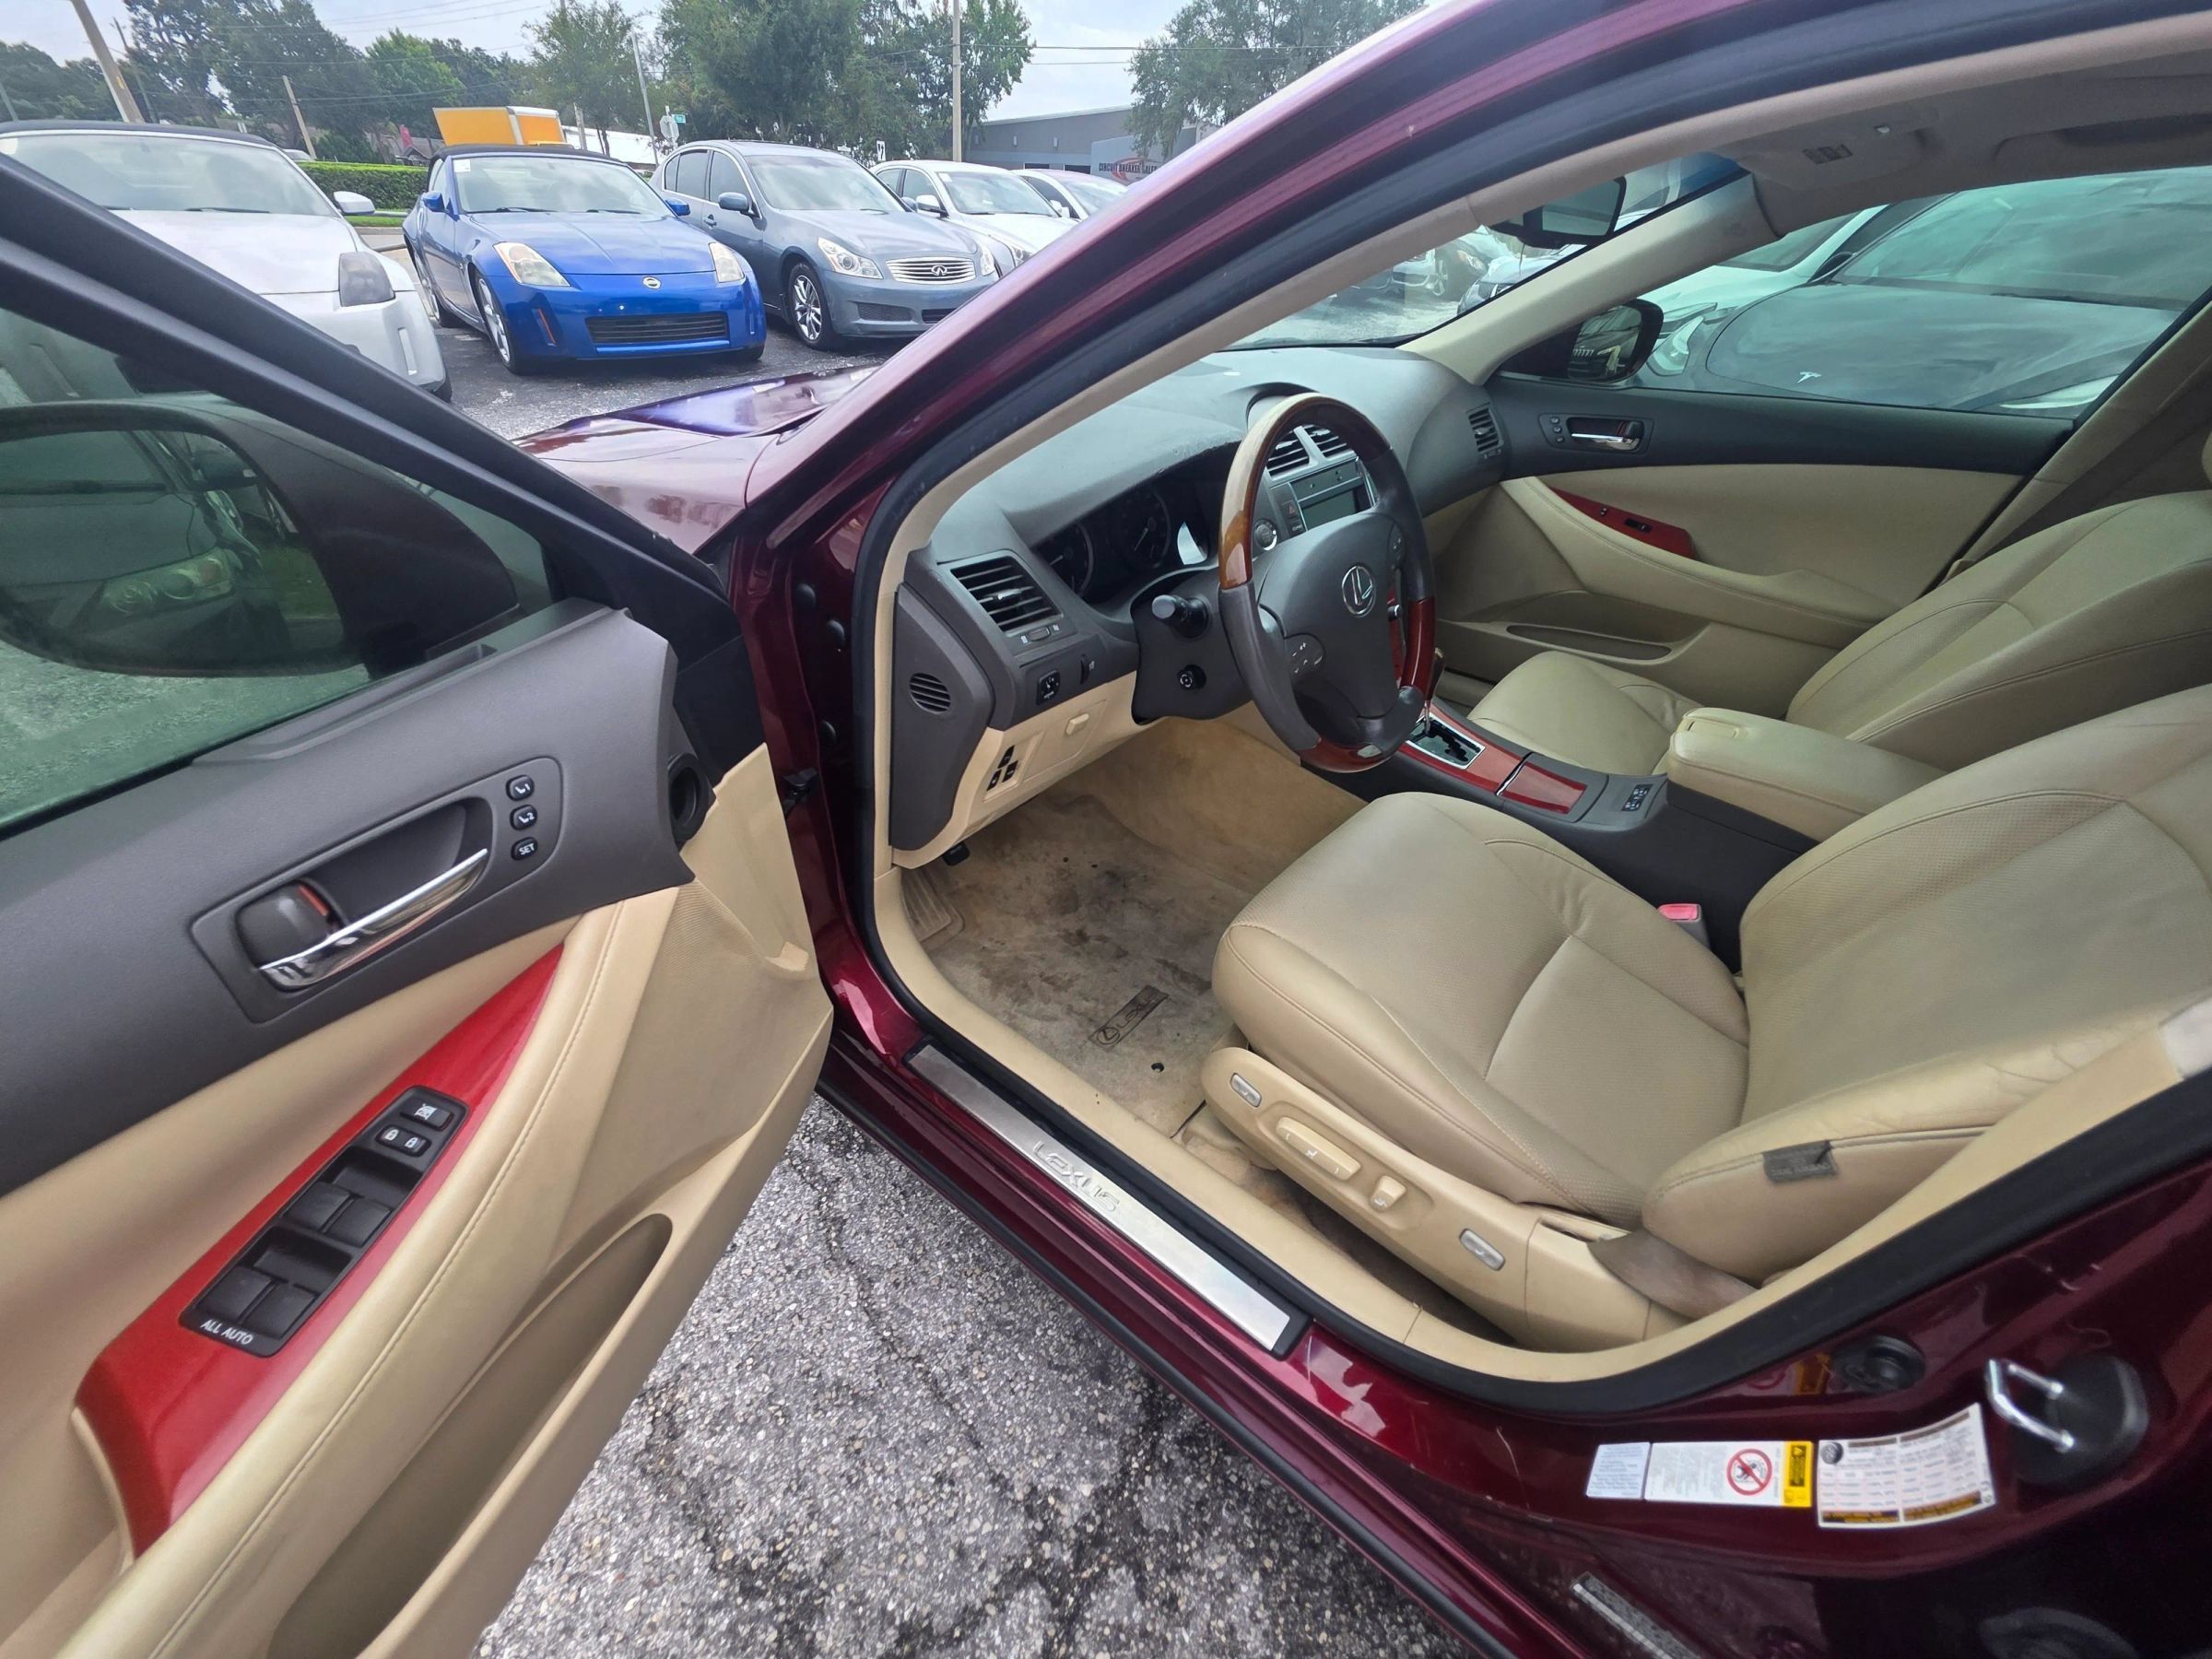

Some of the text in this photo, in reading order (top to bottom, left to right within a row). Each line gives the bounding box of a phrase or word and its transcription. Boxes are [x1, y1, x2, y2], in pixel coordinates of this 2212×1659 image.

[1099, 162, 1118, 172] CIRCUIT
[1118, 163, 1141, 173] BREAKER
[519, 842, 535, 855] SET
[1032, 1140, 1121, 1212] LEXUS
[200, 1319, 254, 1345] ALL AUTO
